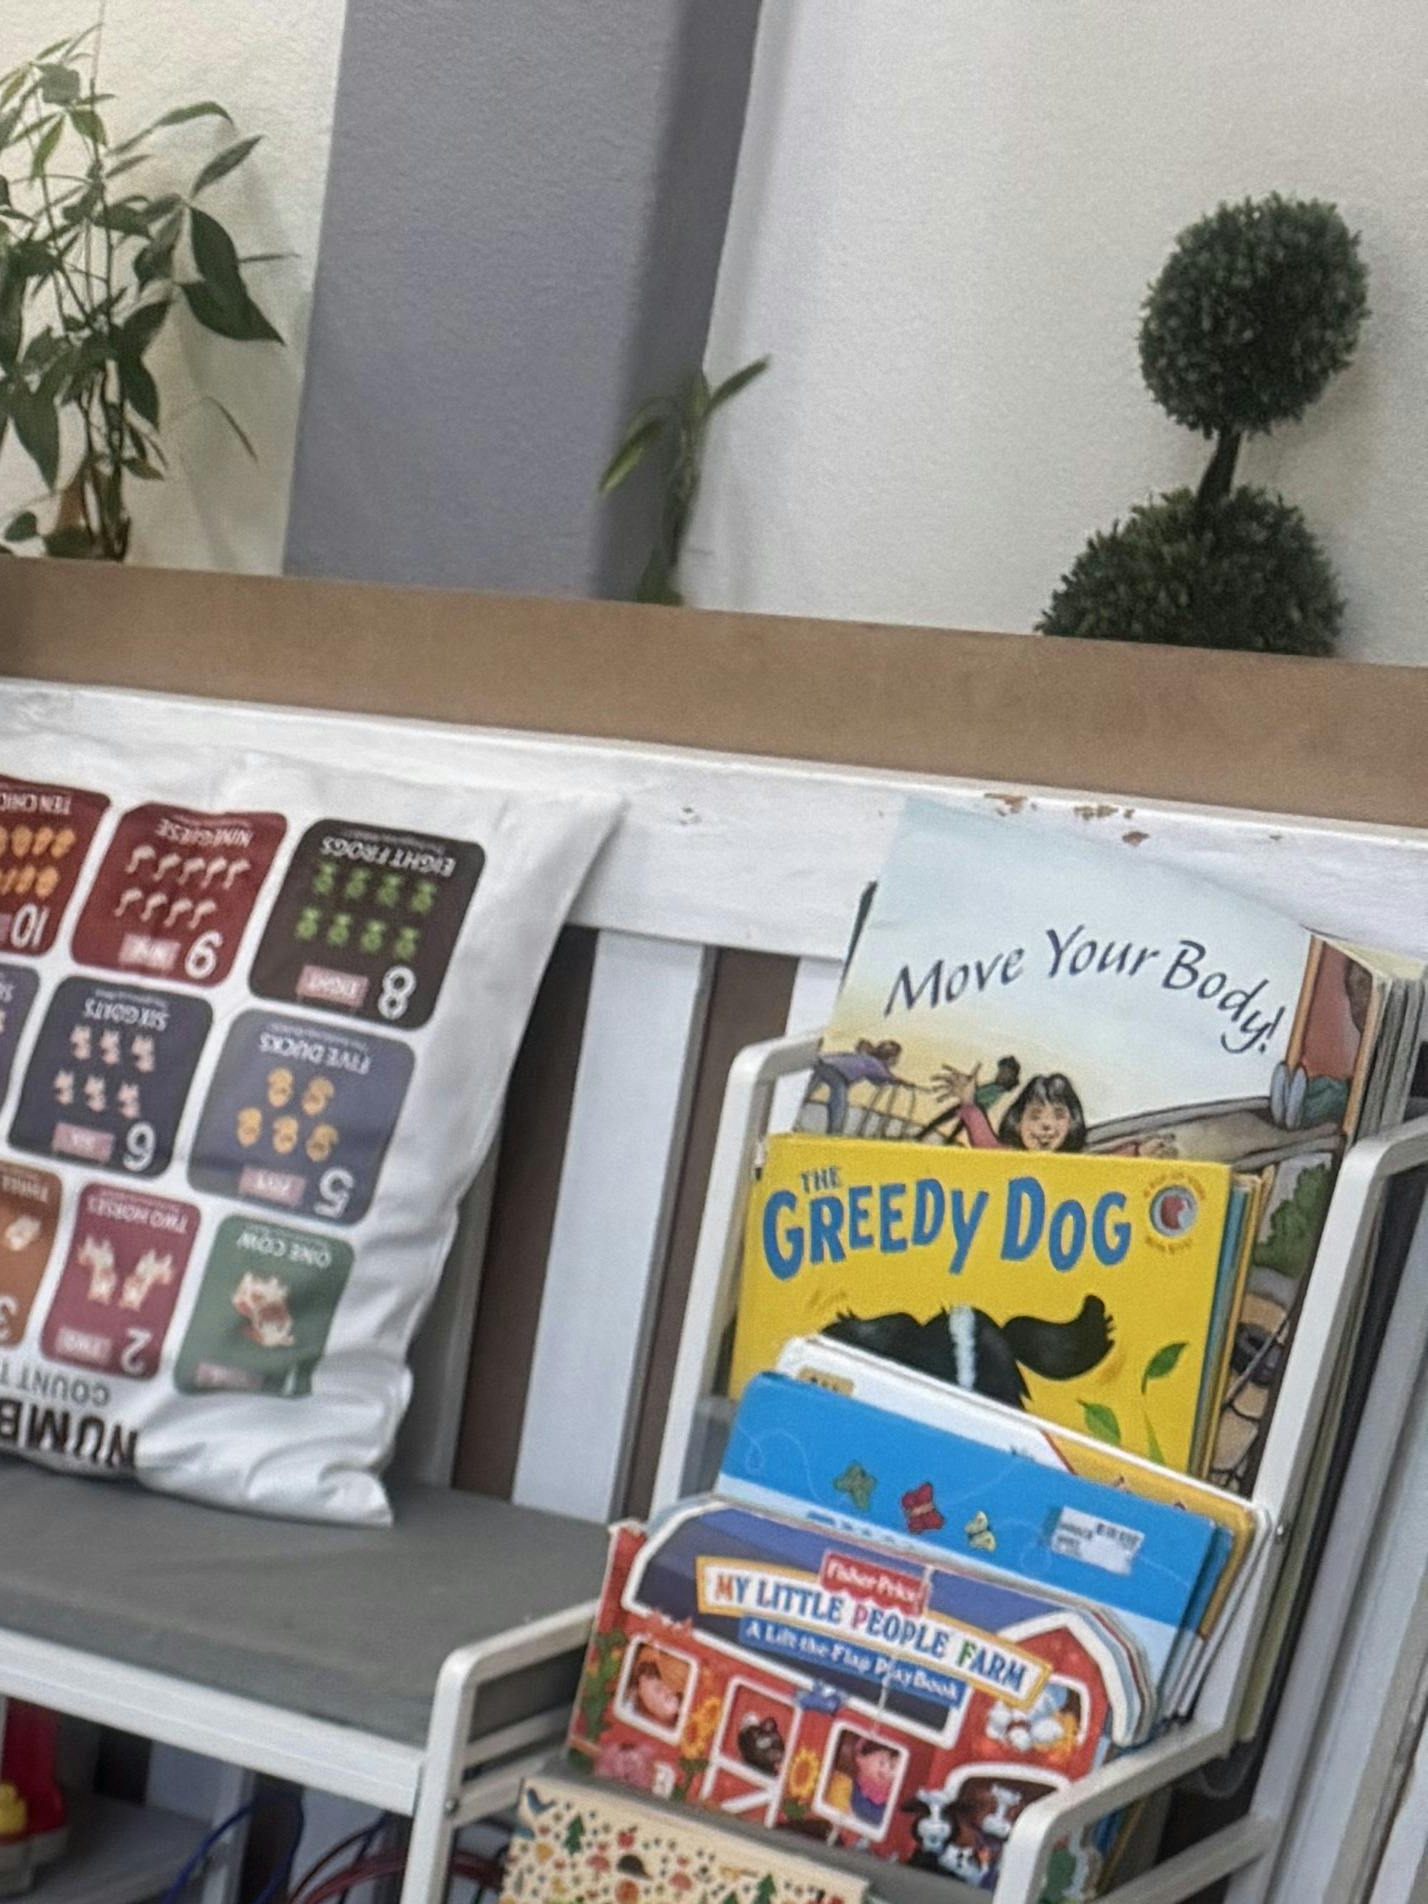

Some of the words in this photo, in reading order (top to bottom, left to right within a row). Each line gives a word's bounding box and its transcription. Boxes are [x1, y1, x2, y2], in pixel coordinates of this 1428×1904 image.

[321, 835, 392, 866] FROGS
[390, 850, 458, 879] EIGHT
[10, 902, 51, 950] 10
[184, 929, 225, 982] 9
[376, 965, 418, 1022] 8
[883, 946, 1026, 1019] Move
[1046, 924, 1160, 979] Your
[1161, 938, 1287, 1056] Body!
[258, 1031, 326, 1065] DUCKS
[326, 1044, 373, 1077] FIVE
[120, 1120, 158, 1175] 6
[314, 1168, 356, 1219] 5
[801, 1165, 842, 1195] THE
[235, 1232, 290, 1259] COW
[763, 1178, 990, 1281] GREEDY
[1000, 1176, 1133, 1272] DOG
[293, 1245, 333, 1269] ONE
[120, 1328, 153, 1375] 2
[17, 1364, 111, 1408] COUNT
[714, 1573, 755, 1605] MY
[756, 1579, 844, 1623] LITTLE
[851, 1604, 949, 1657] PEOPLE
[957, 1639, 1028, 1693] FARM
[746, 1621, 761, 1638] A
